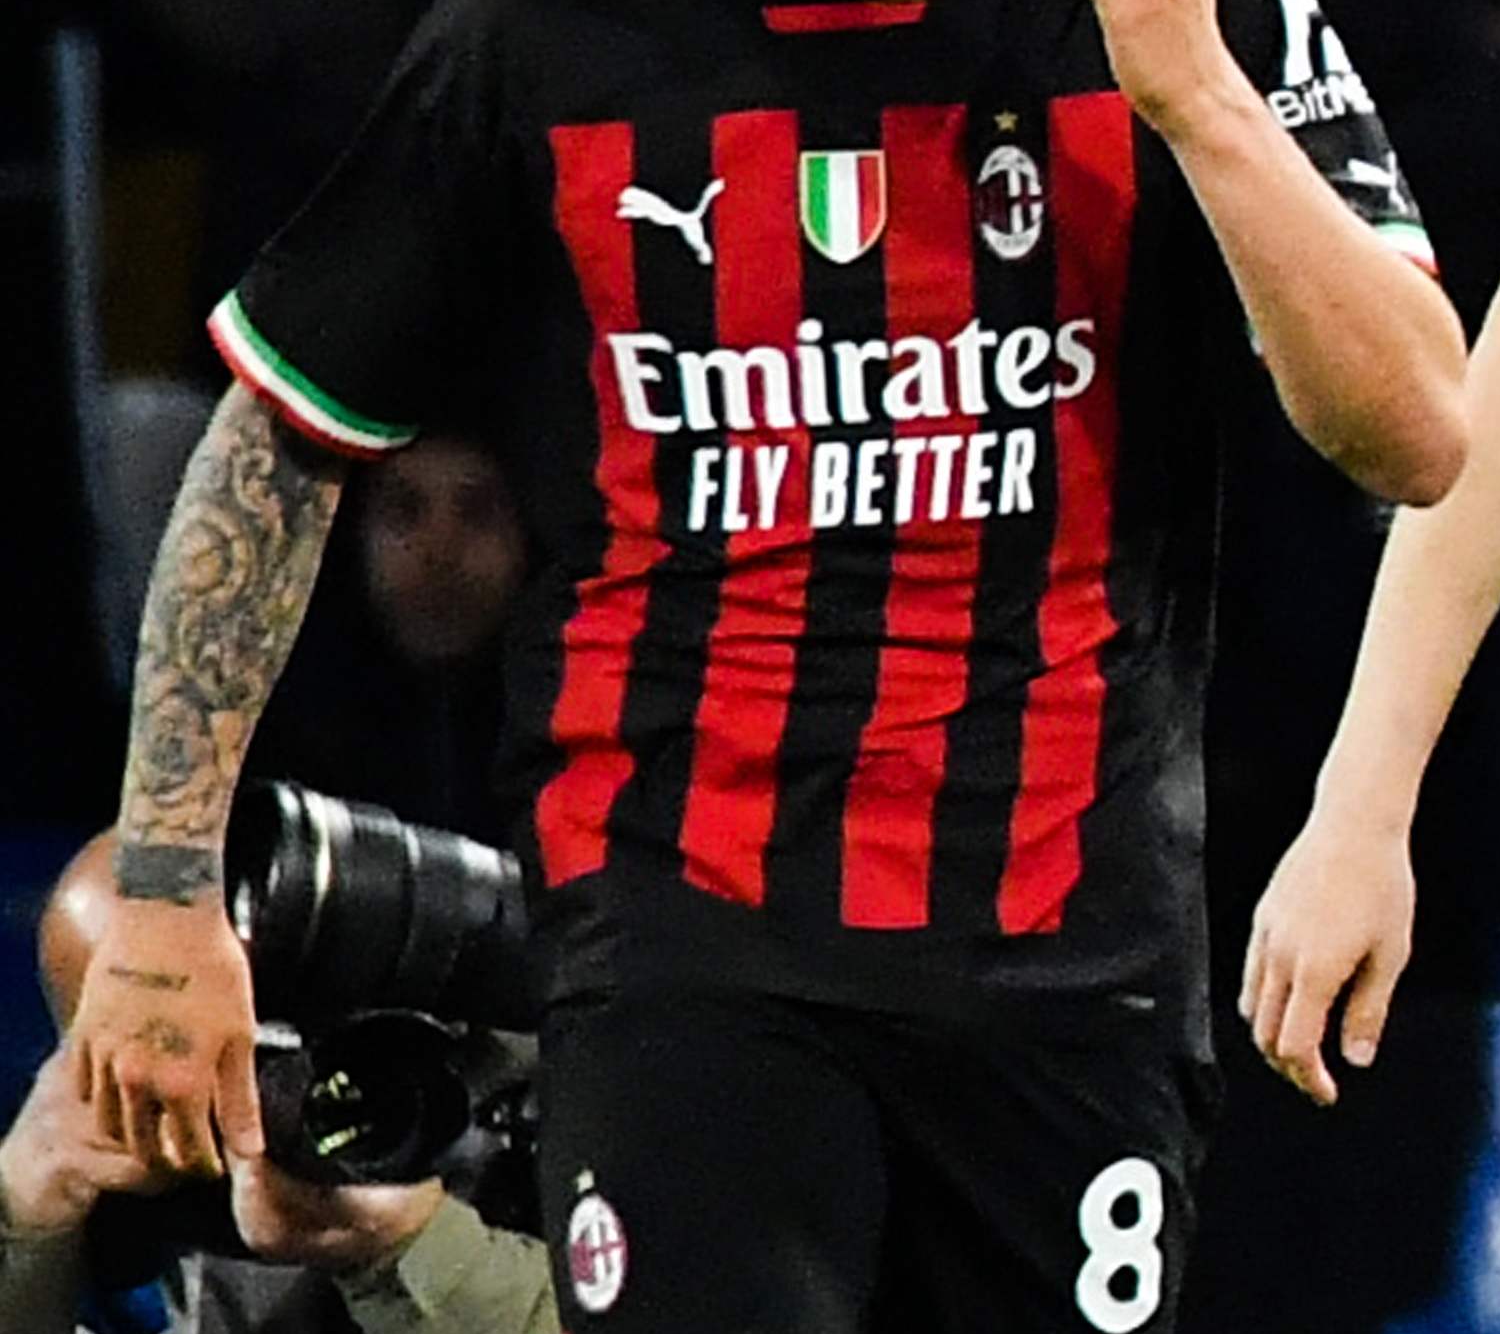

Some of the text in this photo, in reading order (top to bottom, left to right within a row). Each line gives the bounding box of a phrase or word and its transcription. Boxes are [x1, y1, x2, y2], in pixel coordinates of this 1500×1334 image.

[606, 317, 1097, 433] Emirates
[687, 427, 1037, 532] FLY BETTER
